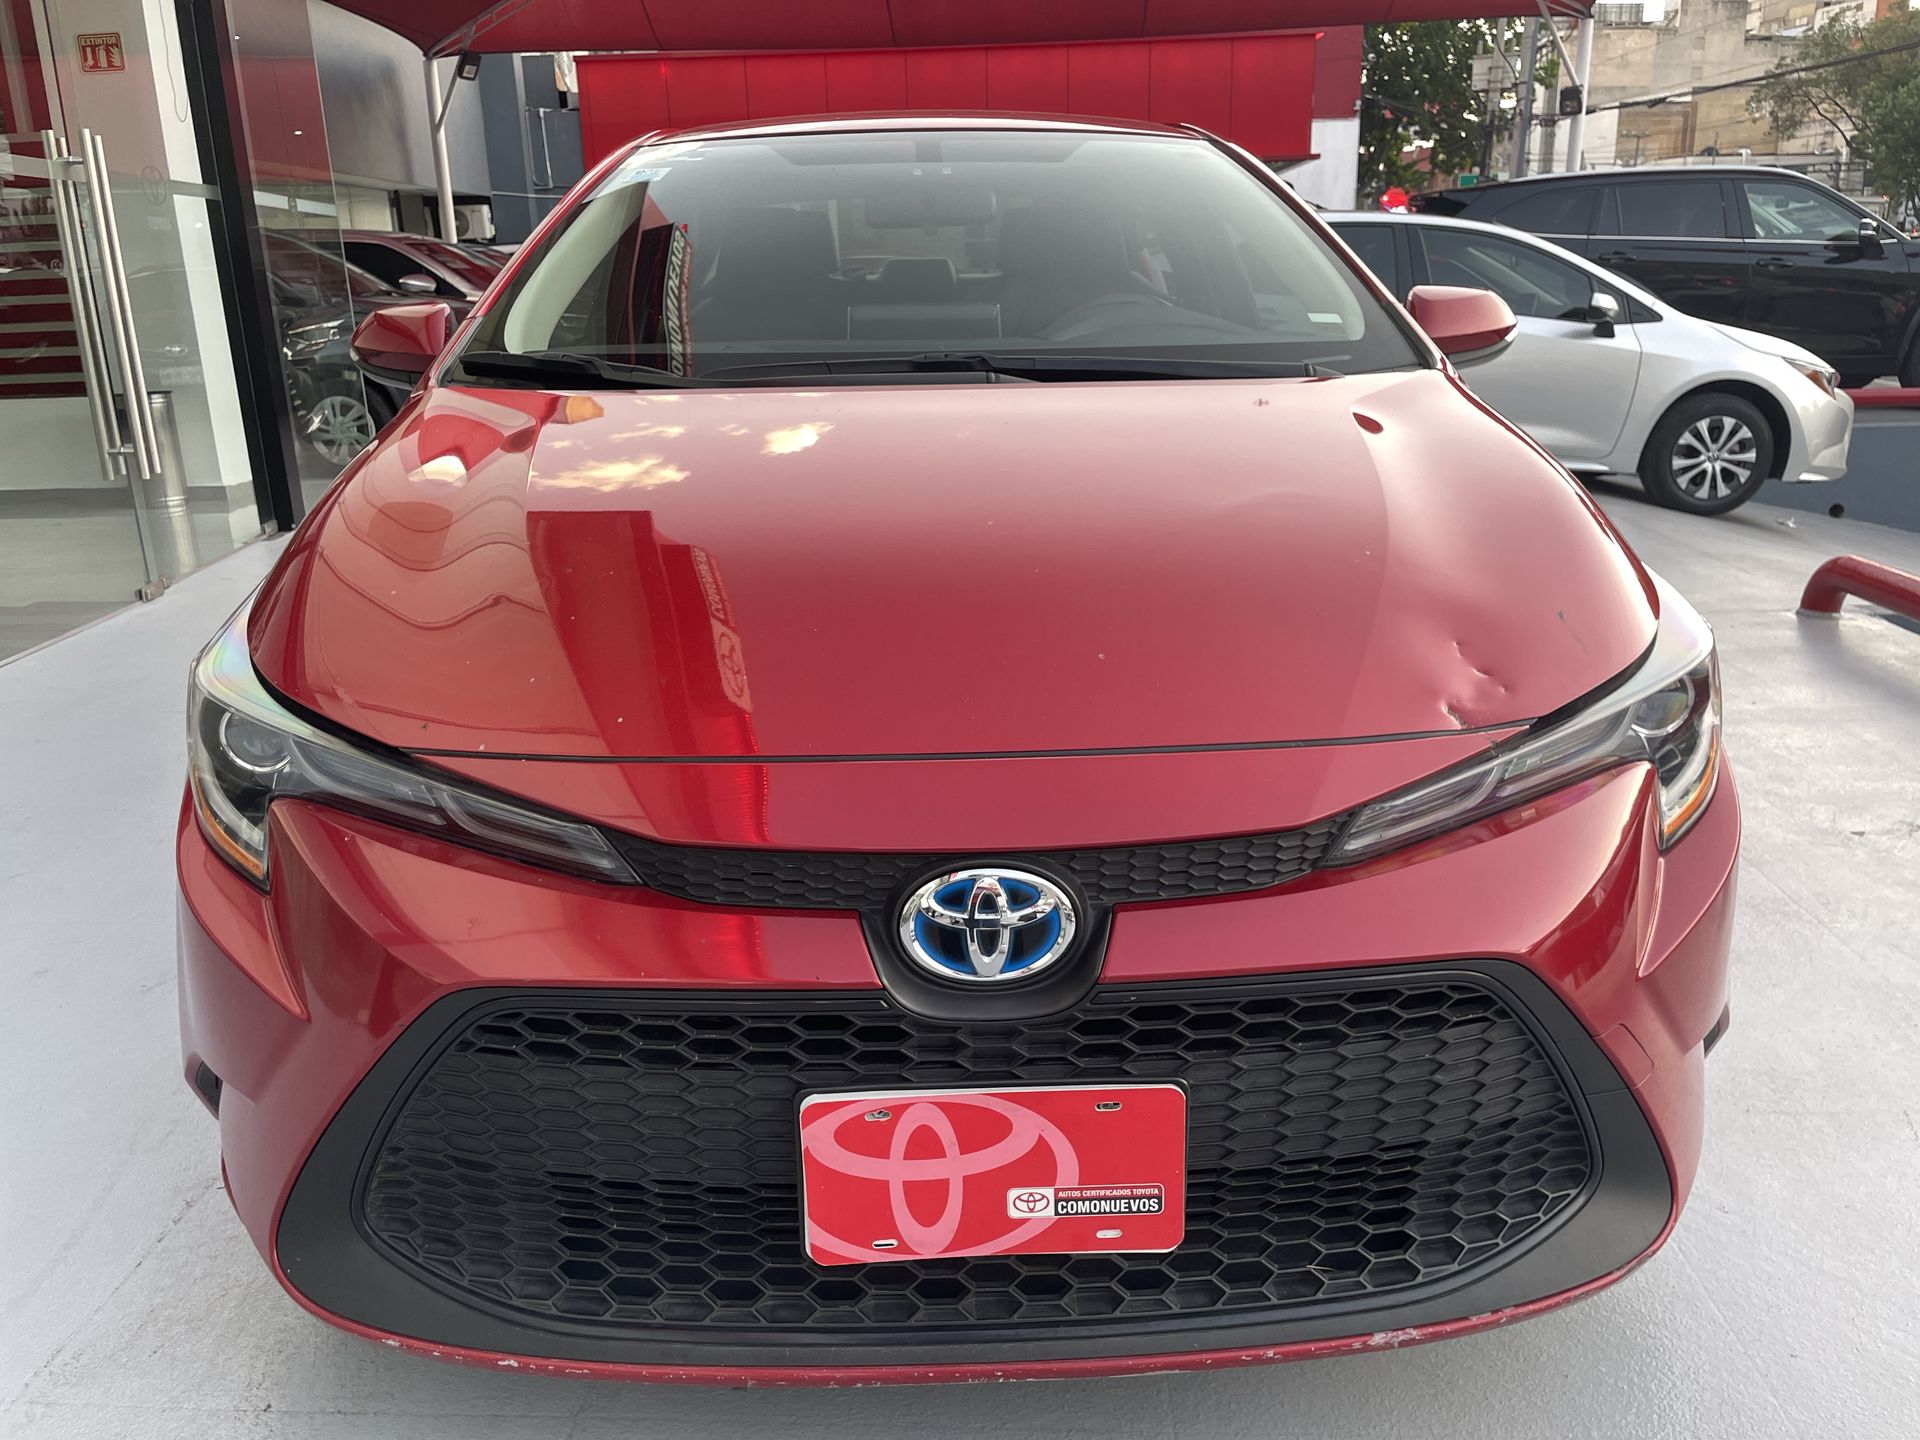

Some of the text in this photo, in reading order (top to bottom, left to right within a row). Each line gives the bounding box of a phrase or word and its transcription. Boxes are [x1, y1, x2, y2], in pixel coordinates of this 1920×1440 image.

[81, 37, 118, 46] EXTINTOR
[1058, 1187, 1159, 1198] AUTOS CERTIFICADOS TOYOTA
[1057, 1198, 1159, 1215] COMONUEVOS
